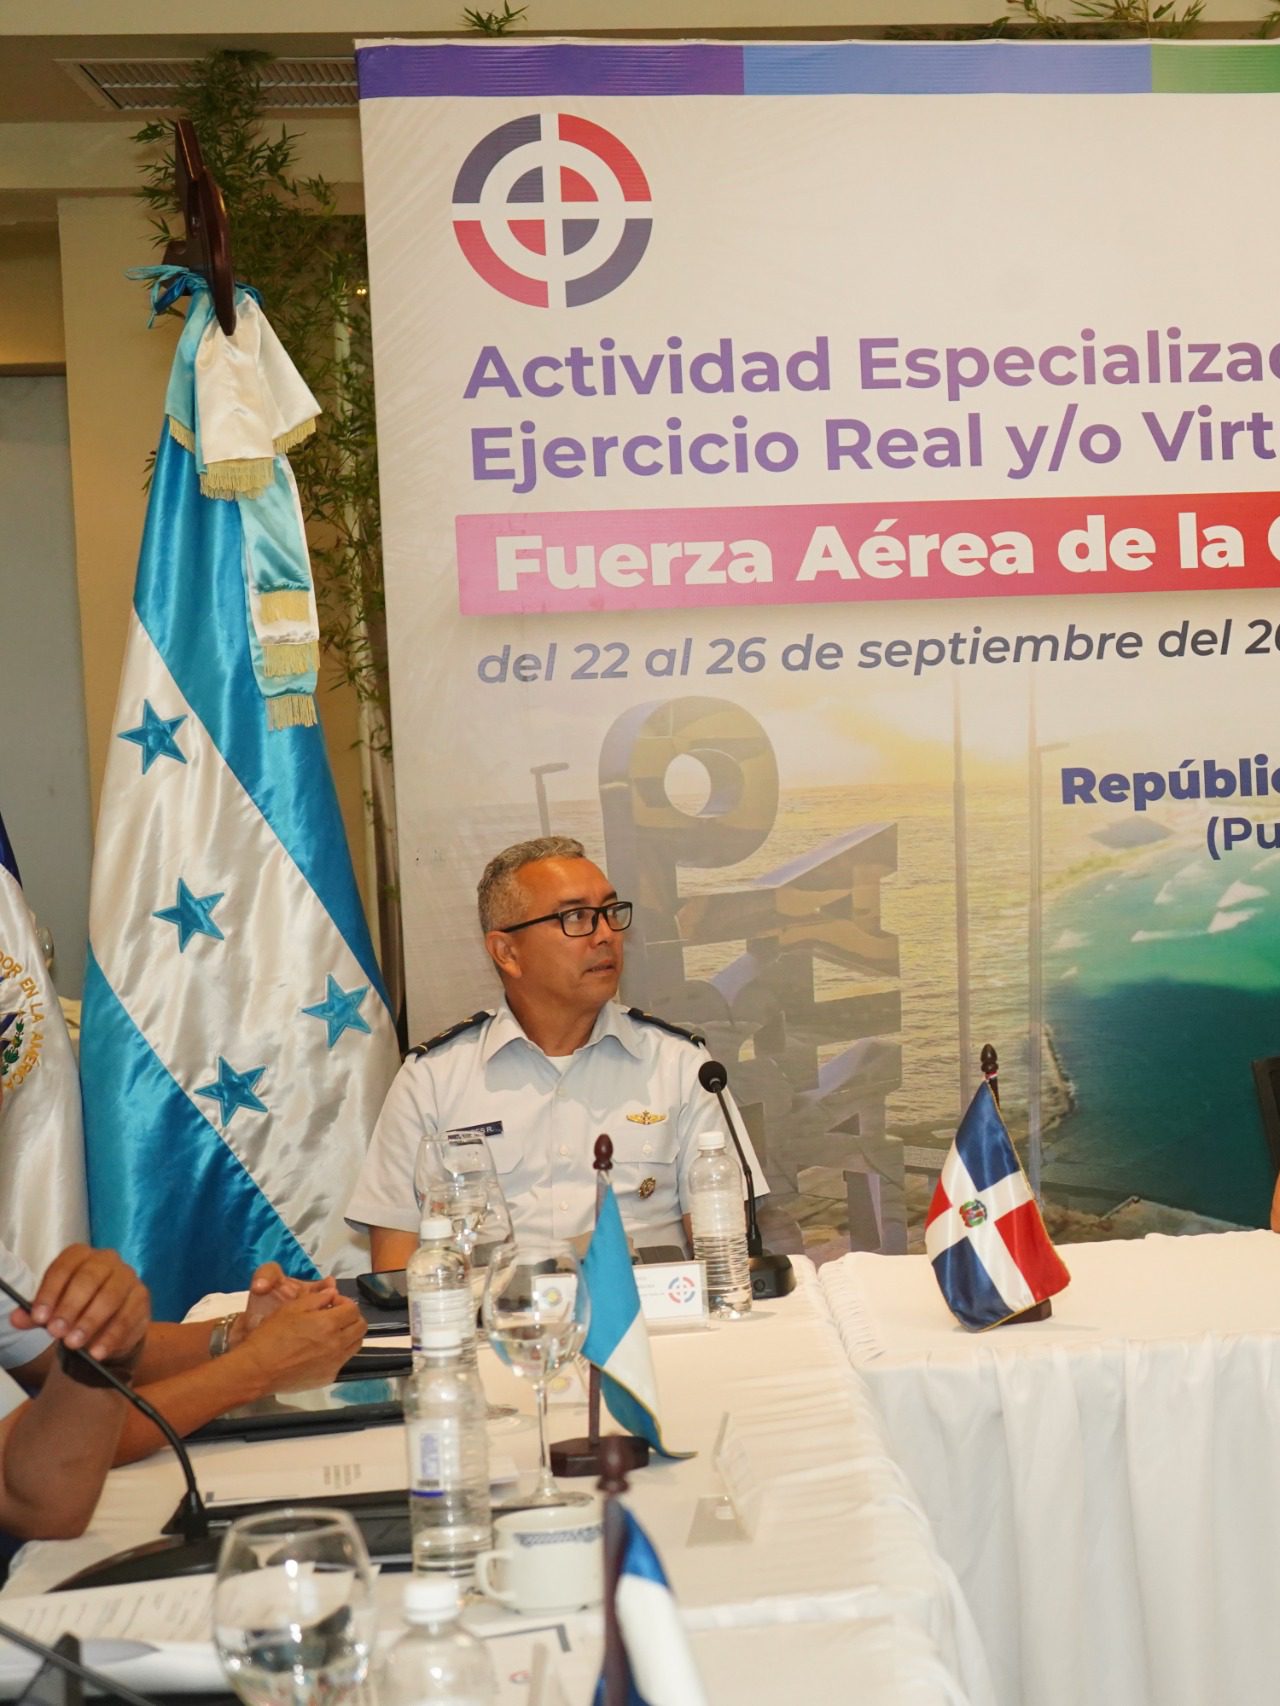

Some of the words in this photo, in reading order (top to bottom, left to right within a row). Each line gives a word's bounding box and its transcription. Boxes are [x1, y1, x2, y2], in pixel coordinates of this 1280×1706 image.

[463, 336, 831, 399] Actividad
[471, 415, 799, 494] Ejercicio
[825, 412, 983, 471] Real
[1005, 403, 1122, 480] y/o
[495, 534, 774, 591] Fuerza
[795, 518, 1035, 581] Aérea
[1058, 514, 1156, 572] de
[1178, 512, 1246, 569] la
[477, 643, 558, 683] del
[571, 641, 630, 680] 22
[645, 638, 693, 677] al
[706, 636, 767, 675] 26
[781, 633, 843, 671] de
[858, 624, 1143, 676] septiembre
[1158, 619, 1233, 658] del
